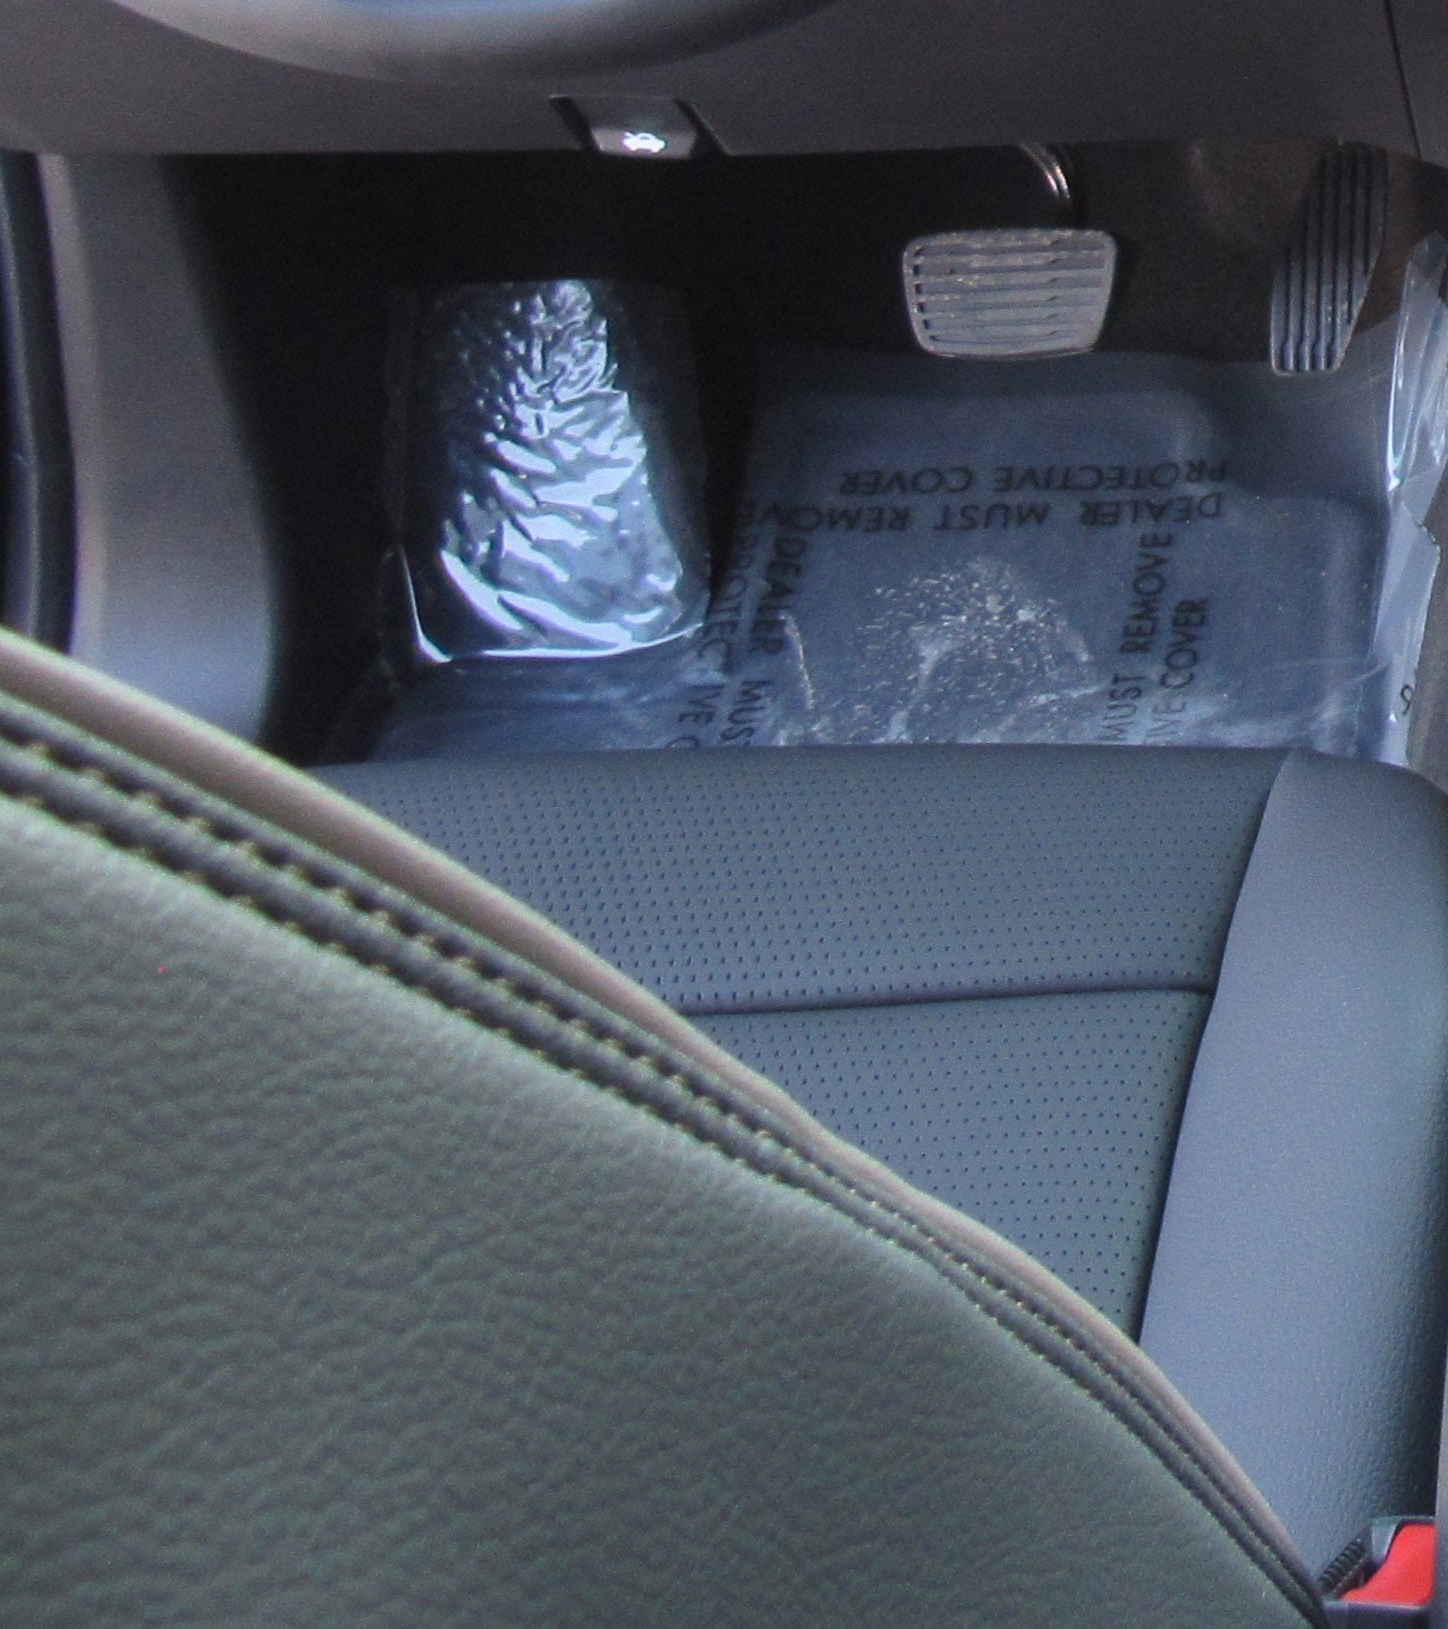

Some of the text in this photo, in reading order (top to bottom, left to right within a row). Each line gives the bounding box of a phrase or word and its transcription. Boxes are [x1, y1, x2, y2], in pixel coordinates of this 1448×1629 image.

[838, 458, 1227, 496] PROTECTIVE COVER
[932, 501, 1051, 533] MUST
[1079, 492, 1222, 527] DEALER
[1120, 532, 1175, 654] REMOVE
[1159, 597, 1210, 689] COVER
[720, 680, 776, 747] MUS
